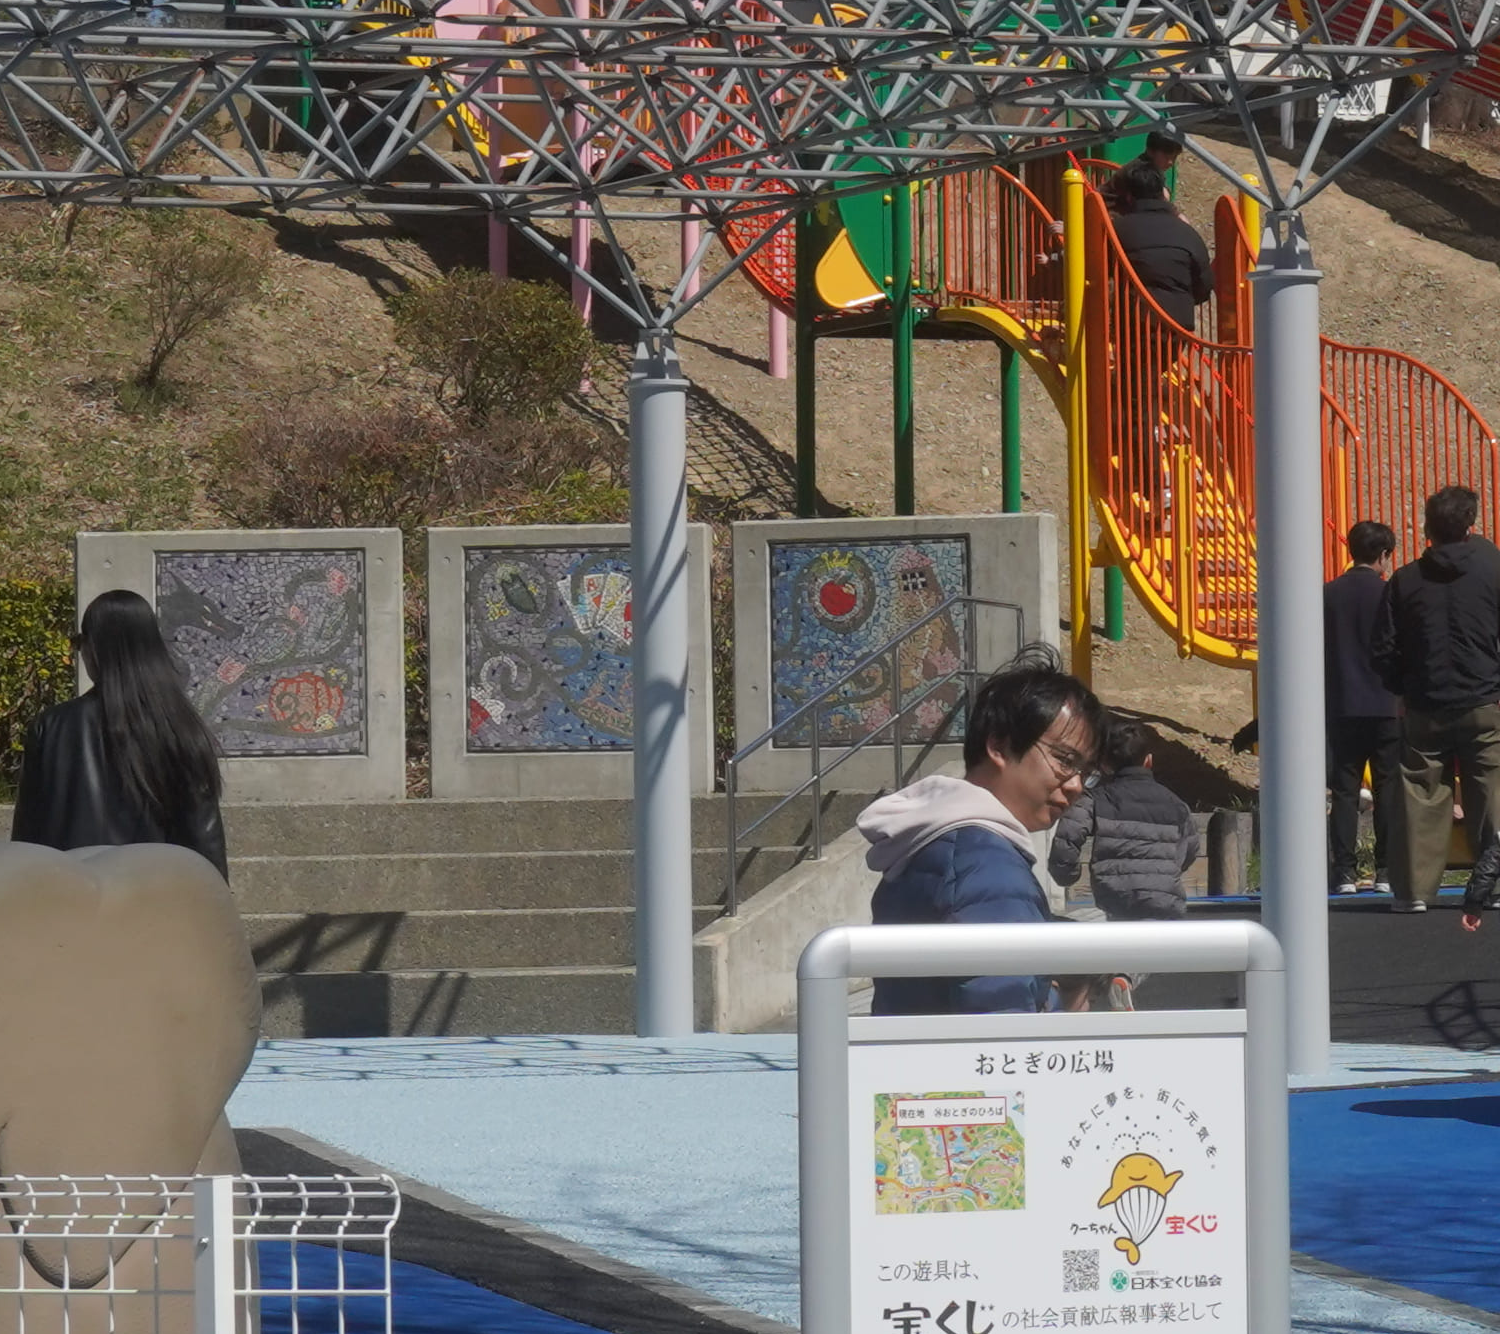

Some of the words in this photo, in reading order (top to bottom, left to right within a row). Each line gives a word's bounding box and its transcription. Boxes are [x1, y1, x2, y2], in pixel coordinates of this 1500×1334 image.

[975, 1050, 1115, 1075] おとぎの広場
[899, 1107, 925, 1119] 現在地
[1070, 1222, 1118, 1235] クーちゃん
[1165, 1214, 1218, 1235] 宝くじ
[878, 1259, 980, 1282] この遊具は、
[1131, 1274, 1223, 1290] 日本宝くじ協会
[1002, 1301, 1223, 1329] の社会貢献広報事業として
